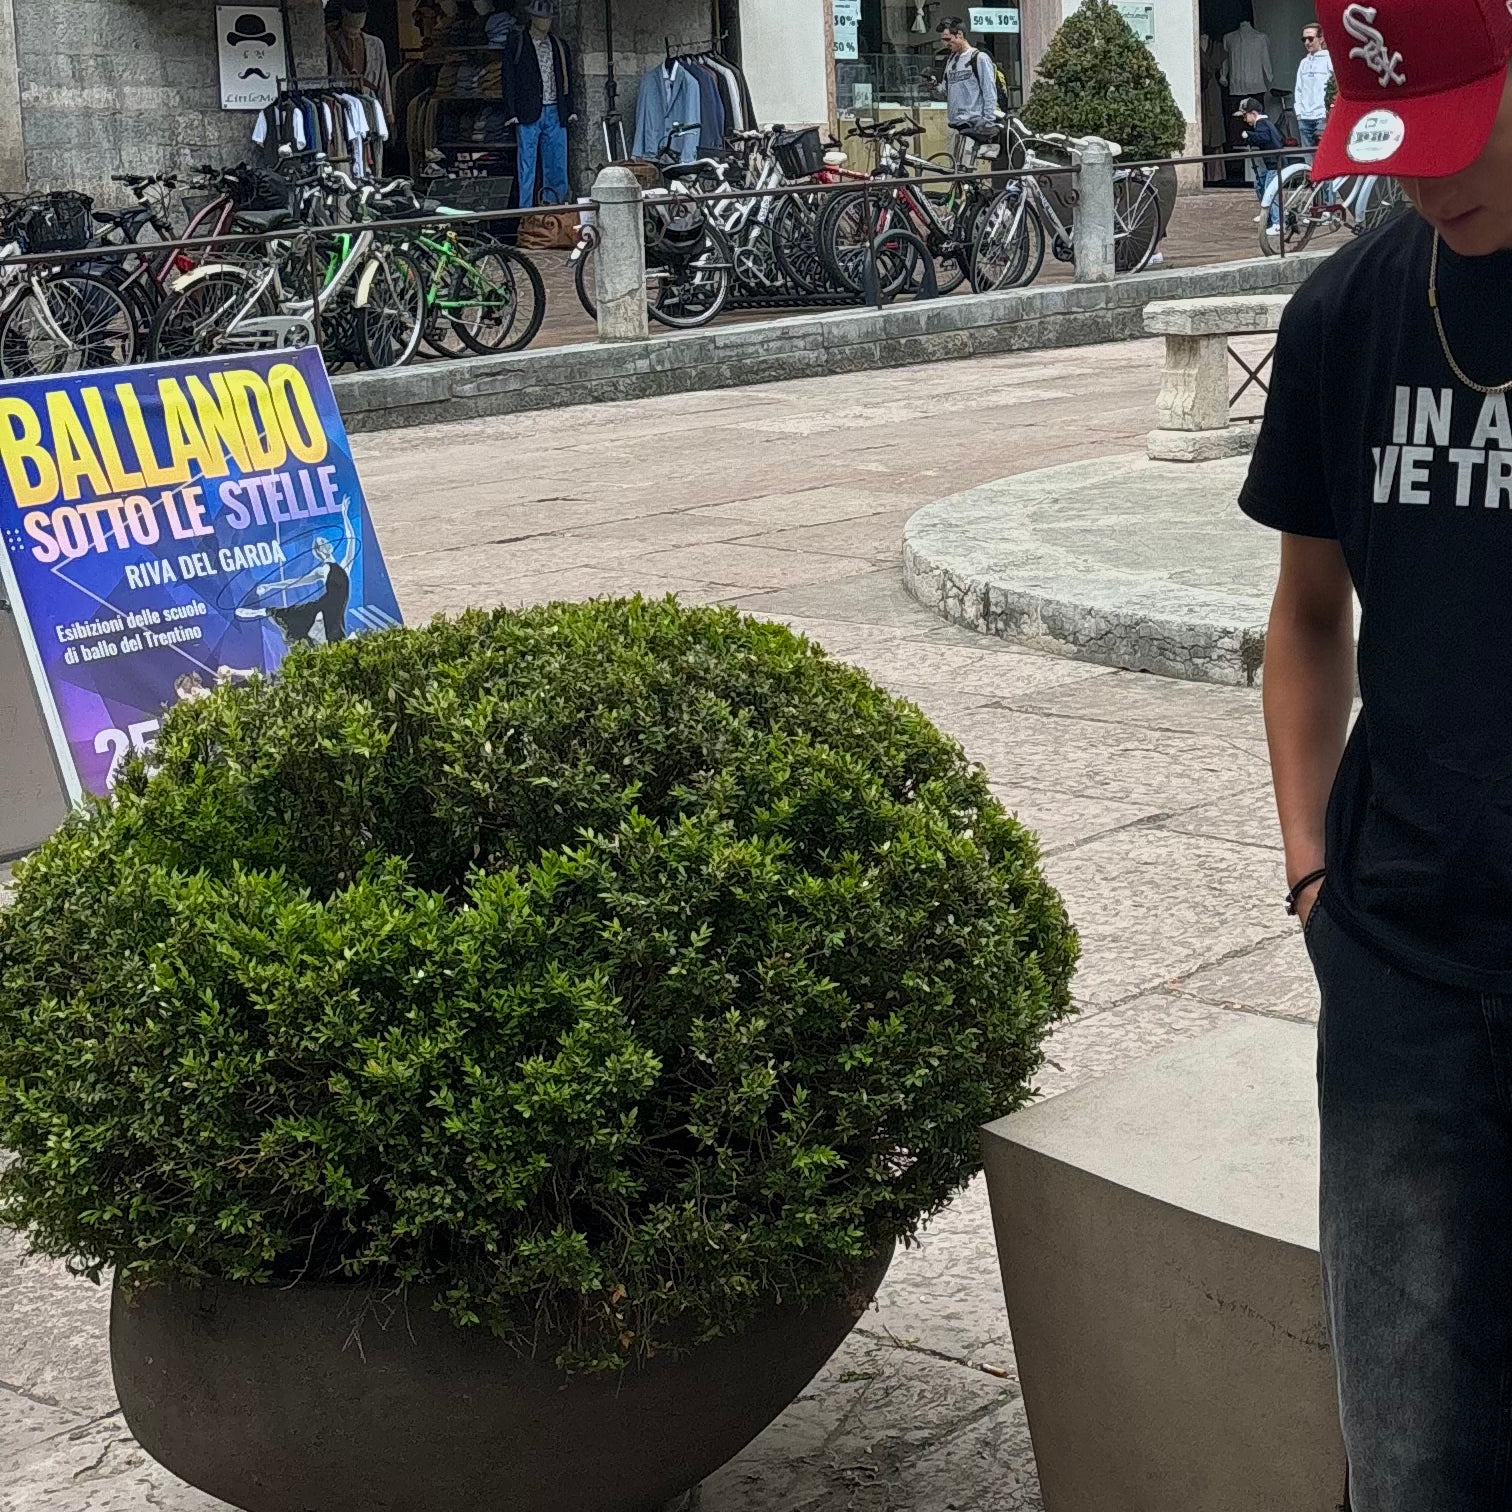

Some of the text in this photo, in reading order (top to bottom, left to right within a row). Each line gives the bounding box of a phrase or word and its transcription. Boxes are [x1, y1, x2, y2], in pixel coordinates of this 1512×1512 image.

[225, 92, 274, 103] LittleM
[0, 363, 329, 508] BALLANDO
[1392, 385, 1453, 447] IN
[24, 465, 343, 563] SOTTO LE STELLE
[125, 539, 287, 590] RIVA DEL GARDA
[55, 599, 207, 643] Esibizioni delle scuole
[63, 625, 202, 665] di ballo del Trentino
